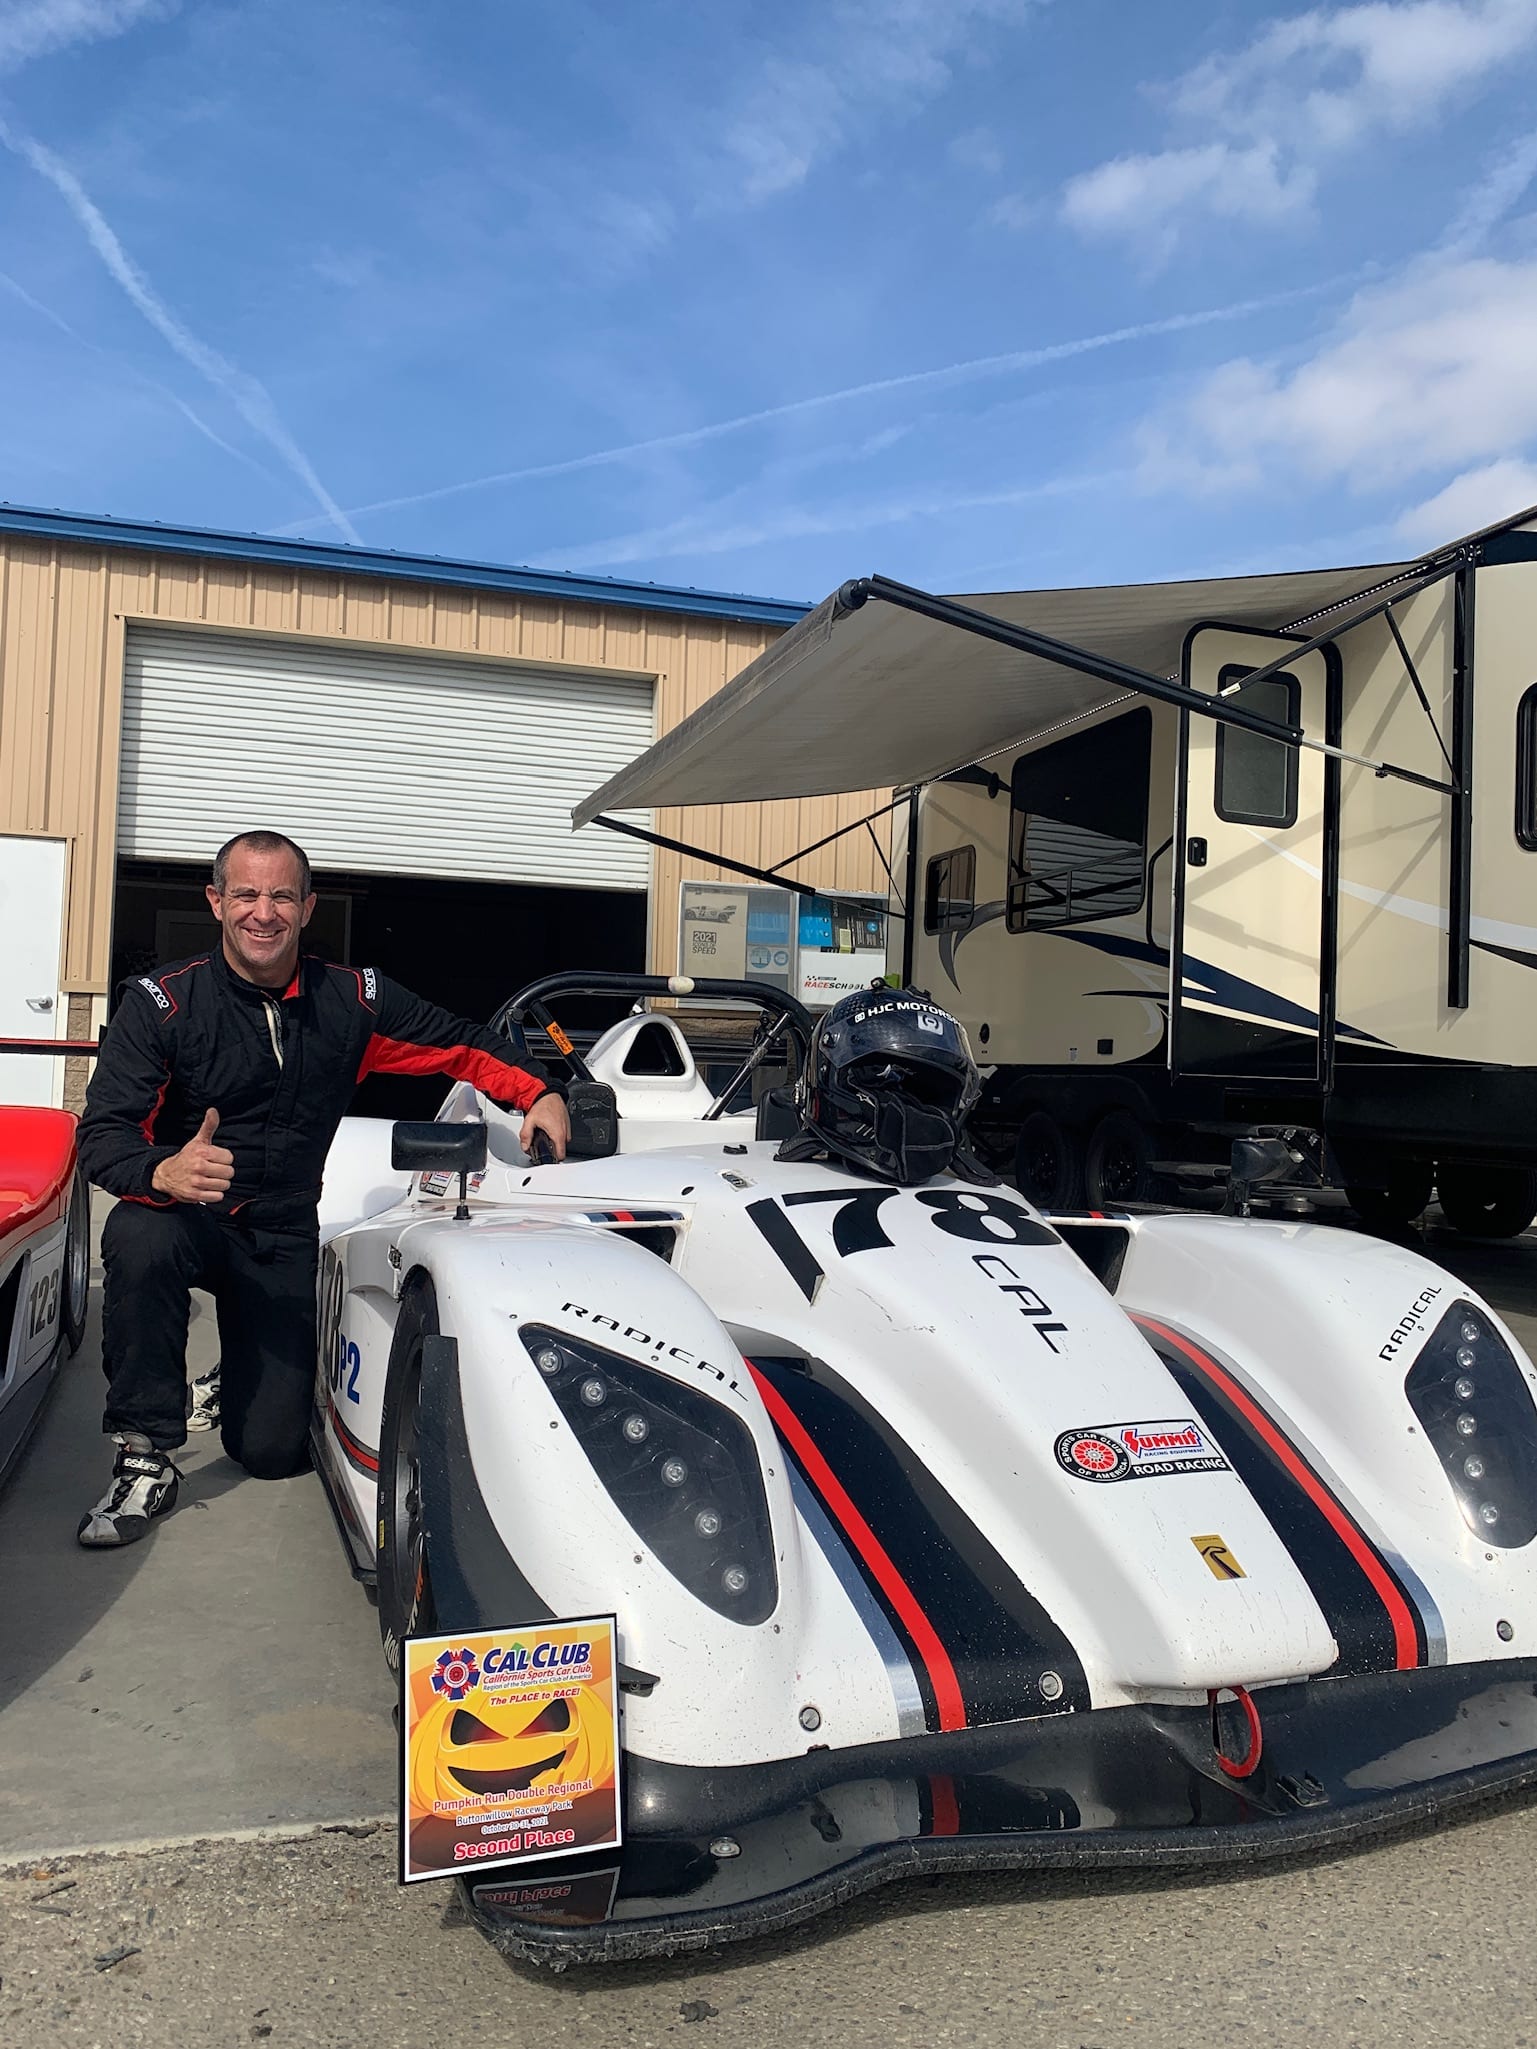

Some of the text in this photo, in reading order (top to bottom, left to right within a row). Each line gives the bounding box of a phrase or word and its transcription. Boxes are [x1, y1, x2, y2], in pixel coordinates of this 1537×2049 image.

[692, 946, 717, 955] SPEED
[694, 932, 716, 943] 2021
[138, 977, 169, 1009] sparco
[363, 968, 377, 1000] sparco
[868, 1003, 894, 1017] HJC
[29, 1268, 59, 1340] 123
[971, 1255, 1069, 1354] CAL
[1379, 1287, 1442, 1362] RADICAL
[561, 1302, 748, 1402] RADICAL
[340, 1333, 361, 1405] P2
[1061, 1432, 1123, 1463] SPORTS CAR CLUB
[1170, 1448, 1205, 1456] EQUIPMENT
[1077, 1467, 1092, 1476] OF
[1132, 1458, 1227, 1476] ROAD RACING
[483, 1643, 590, 1674] CAL CLUB
[483, 1664, 591, 1684] California Sports Car Club
[483, 1683, 503, 1691] Region
[504, 1681, 510, 1689] of
[520, 1679, 538, 1687] Sports
[570, 1673, 592, 1681] America
[490, 1687, 581, 1706] The PLACE to RACE!
[434, 1779, 593, 1811] Pumpkin Run Double Regional
[456, 1800, 572, 1825] Buttonwillow Raceway Park
[482, 1822, 509, 1834] October
[531, 1817, 548, 1827] 2021
[455, 1829, 575, 1859] Second Place
